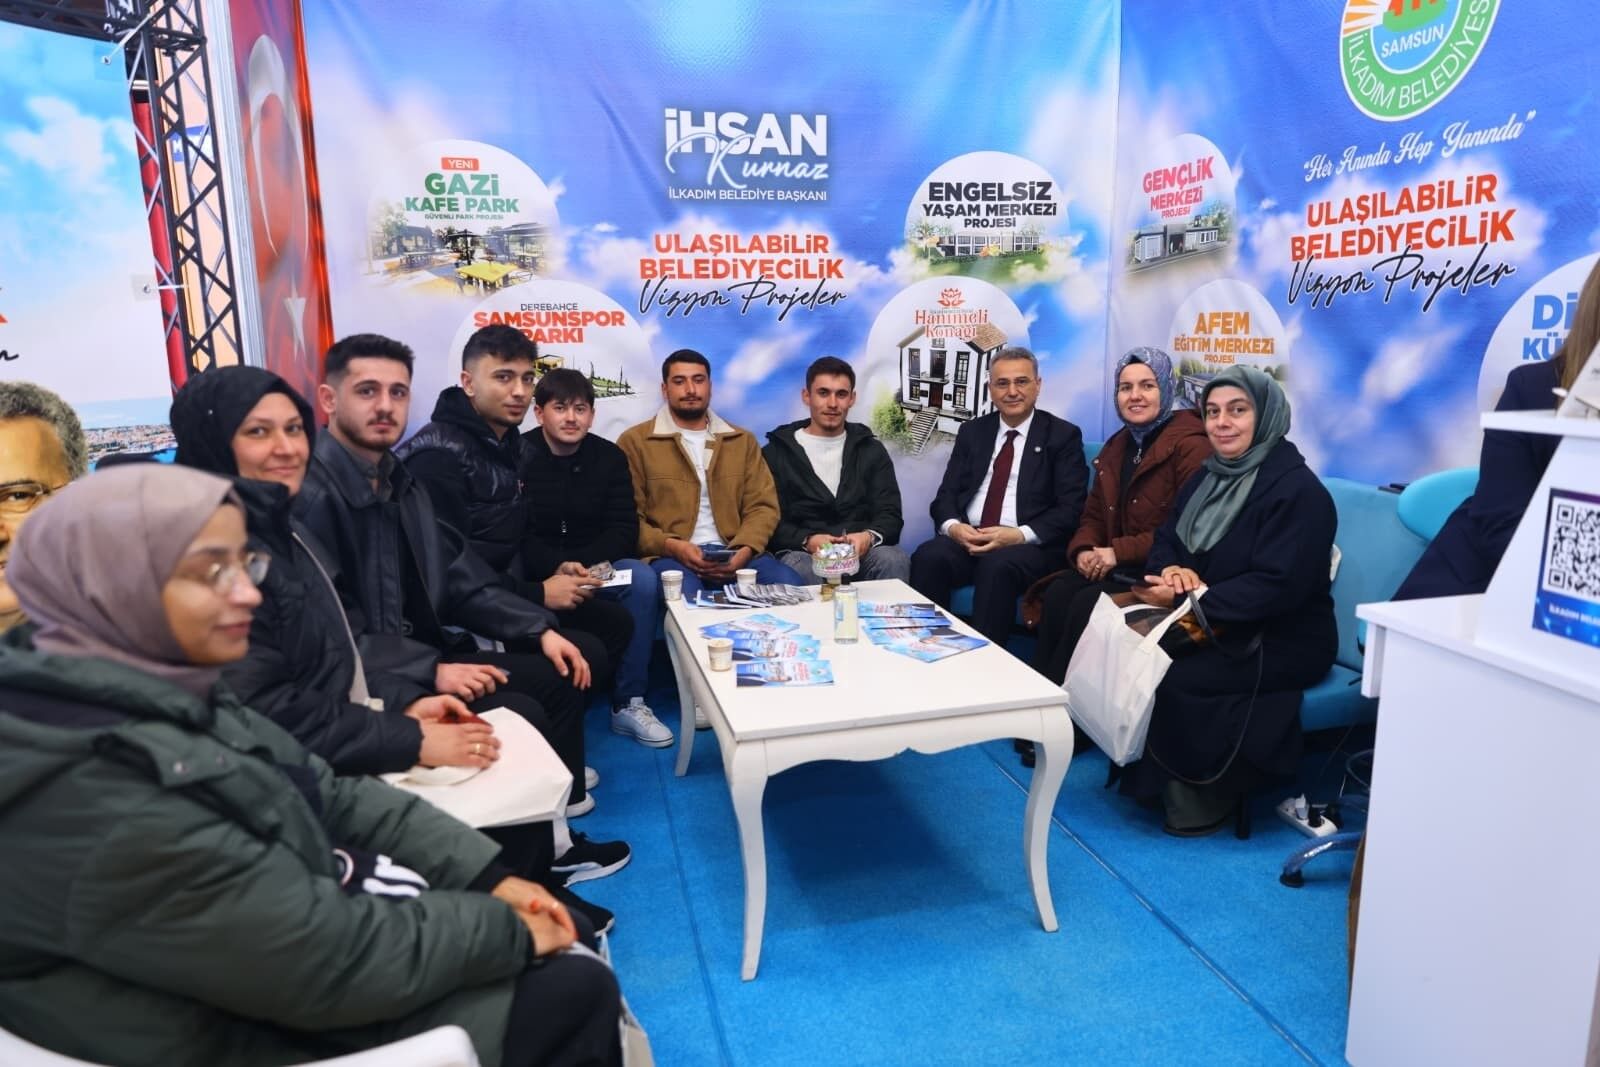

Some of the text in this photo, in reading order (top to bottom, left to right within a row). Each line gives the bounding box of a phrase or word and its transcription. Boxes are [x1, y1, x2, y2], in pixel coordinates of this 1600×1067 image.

[1380, 23, 1444, 59] SAMSUN
[1348, 32, 1396, 110] İLKADIM
[664, 108, 828, 156] İHSAN
[448, 159, 474, 169] YENİ
[665, 132, 829, 189] Kurnaz
[1335, 142, 1392, 175] Anında
[1394, 131, 1434, 164] Hep
[424, 173, 500, 195] GAZİ
[1143, 156, 1214, 193] GENÇLİK
[669, 186, 828, 202] İLKADIM BELEDİYE BAŞKANI
[929, 181, 1052, 201] ENGELSİZ
[1150, 186, 1203, 211] MERKEZİ
[1307, 174, 1498, 227] ULAŞILABİLİR
[405, 197, 519, 212] KAFE PARK
[923, 203, 1057, 218] YAŞAM MERKEZİ
[964, 218, 1016, 228] PROJESİ
[655, 234, 829, 257] ULAŞILABİLİR
[1291, 209, 1516, 261] BELEDİYECİLİK
[639, 258, 844, 280] BELEDİYECİLİK
[1288, 242, 1515, 312] Vizyon Projeler
[639, 275, 847, 321] Vizyon Projeler
[474, 311, 625, 327] SAMSUNSPOR
[1194, 312, 1250, 334] AFEM
[1174, 334, 1275, 354] EĞİTİM MERKEZİ
